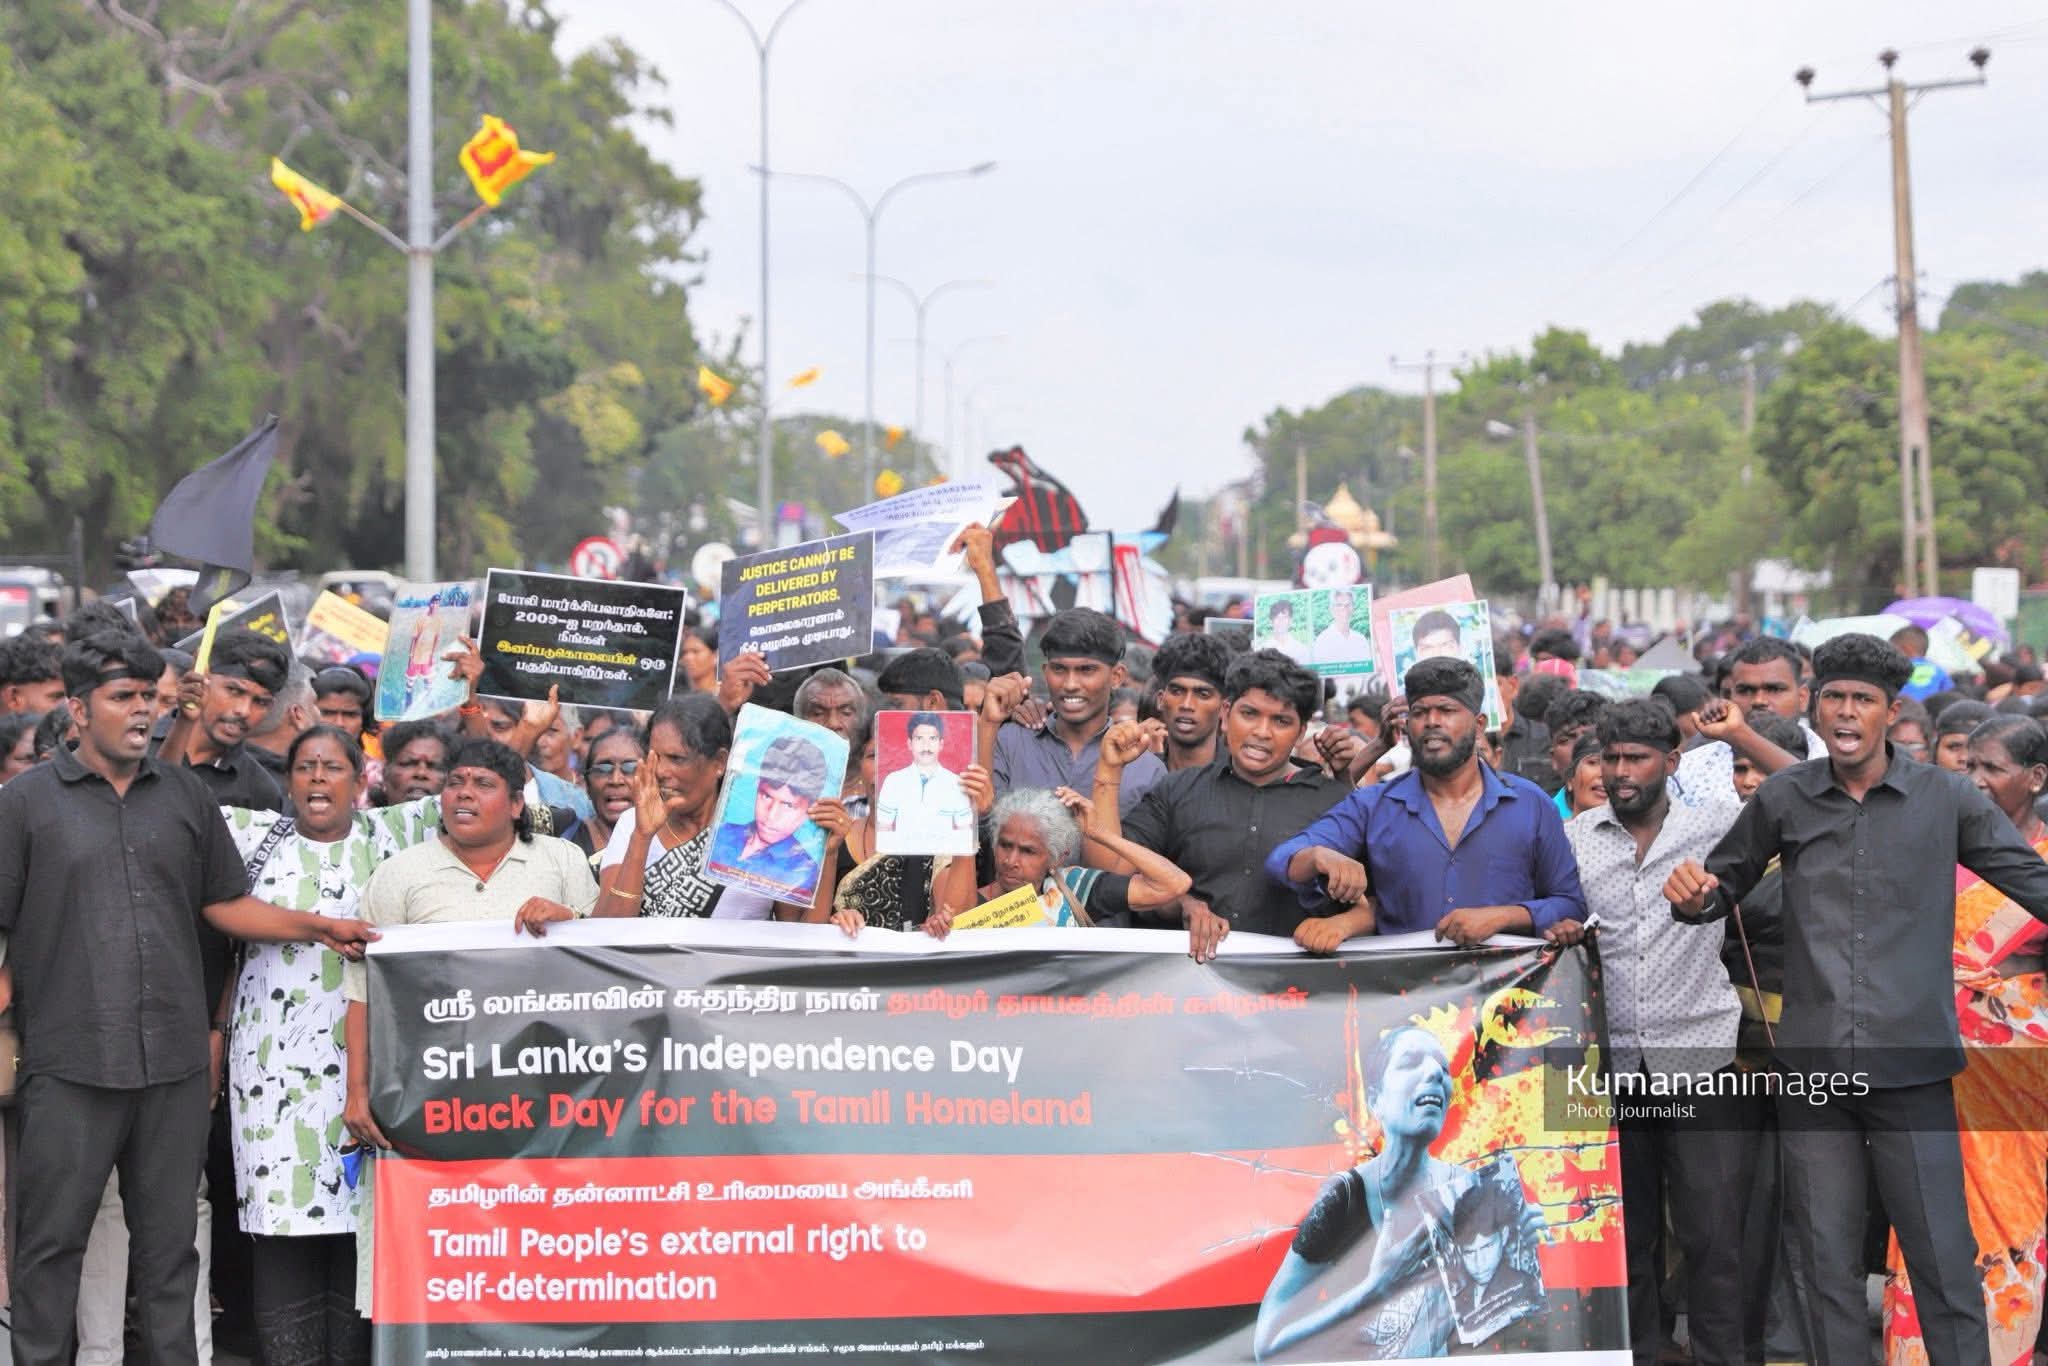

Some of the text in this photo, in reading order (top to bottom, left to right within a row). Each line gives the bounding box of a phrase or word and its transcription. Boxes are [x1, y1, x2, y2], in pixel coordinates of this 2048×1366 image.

[740, 546, 855, 581] JUSTICE CANNOT BE
[755, 569, 838, 597] DELIVERED BY
[498, 592, 539, 606] போலி
[748, 588, 840, 617] PERPETRATORS.
[497, 640, 666, 670] இனப்படுகொலையின் ஒரு
[760, 635, 800, 652] வழங்க
[256, 832, 280, 861] BAG
[483, 984, 667, 1015] லங்காவின்
[672, 984, 797, 1015] சுதந்திர
[805, 986, 881, 1016] நாள்
[887, 988, 990, 1019] தமிழர்
[997, 989, 1175, 1022] தாயகத்தின்
[423, 1035, 1024, 1083] Sri Lanka's Independence Day
[424, 1088, 1093, 1137] Black Day for the Tamil Homeland
[427, 1176, 974, 1210] தமிழரின் தன்னாட்சி உரிமையை அங்கீகரி
[427, 1222, 928, 1263] Tamil People's external right to
[427, 1271, 717, 1302] self-determination
[425, 1347, 449, 1359] தமிழ்
[920, 1340, 944, 1352] தமிழ்
